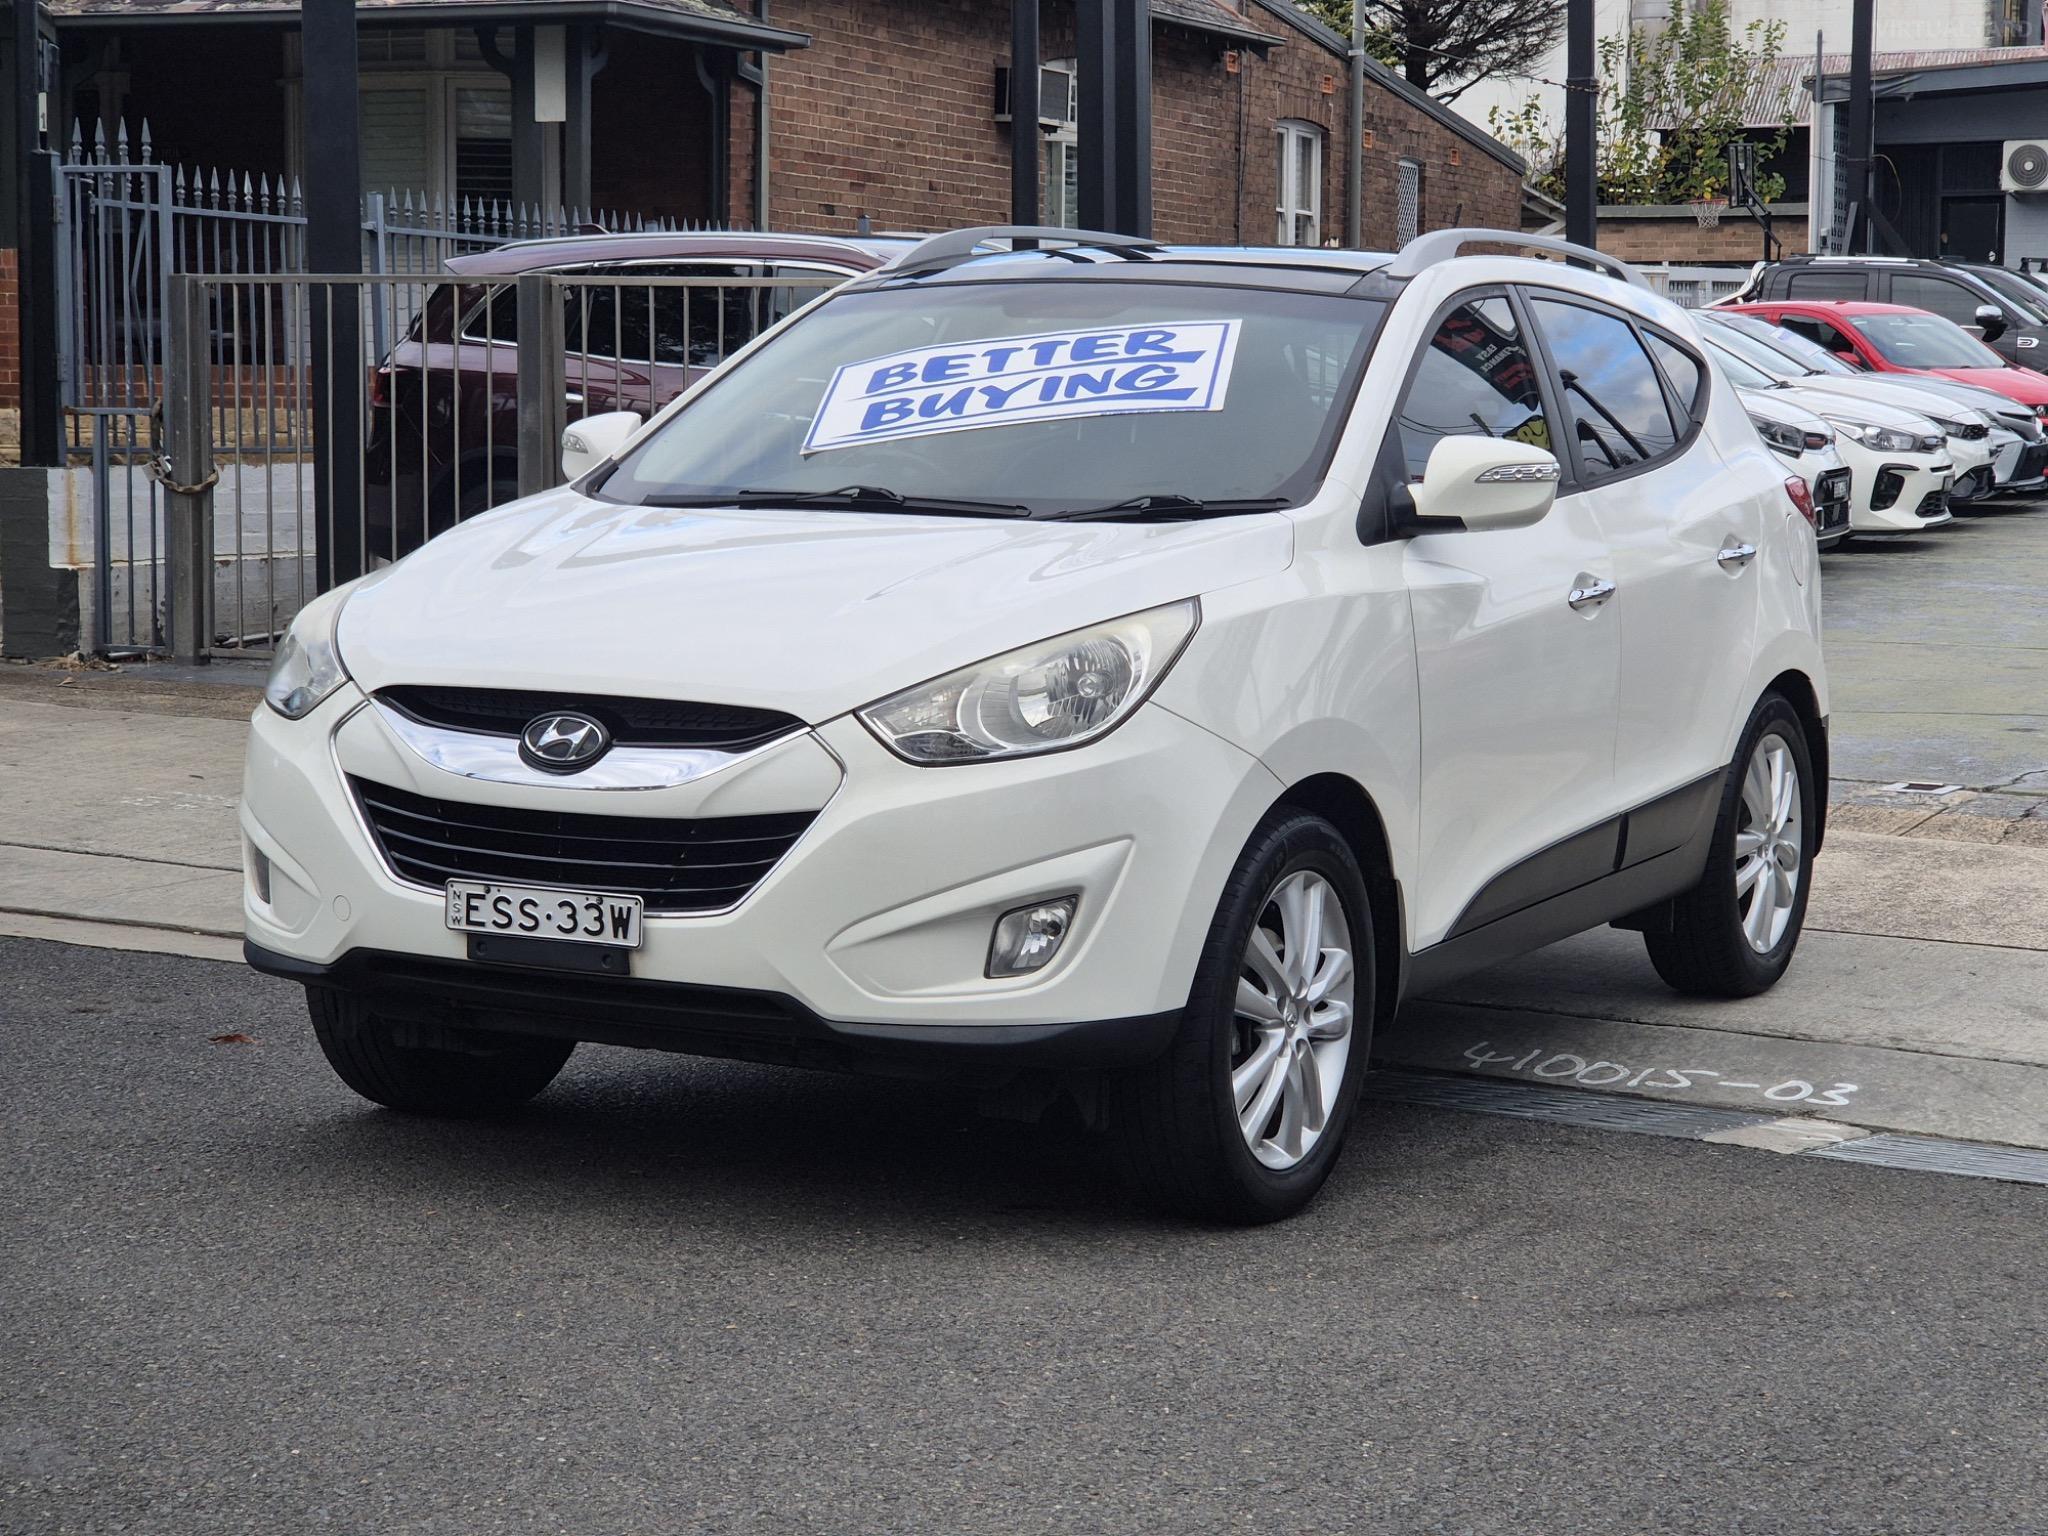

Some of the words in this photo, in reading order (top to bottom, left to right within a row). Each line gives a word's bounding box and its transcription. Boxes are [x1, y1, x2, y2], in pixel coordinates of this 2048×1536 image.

[865, 330, 1177, 394] BETTER
[860, 364, 1179, 430] BUYING
[451, 890, 464, 925] NSW
